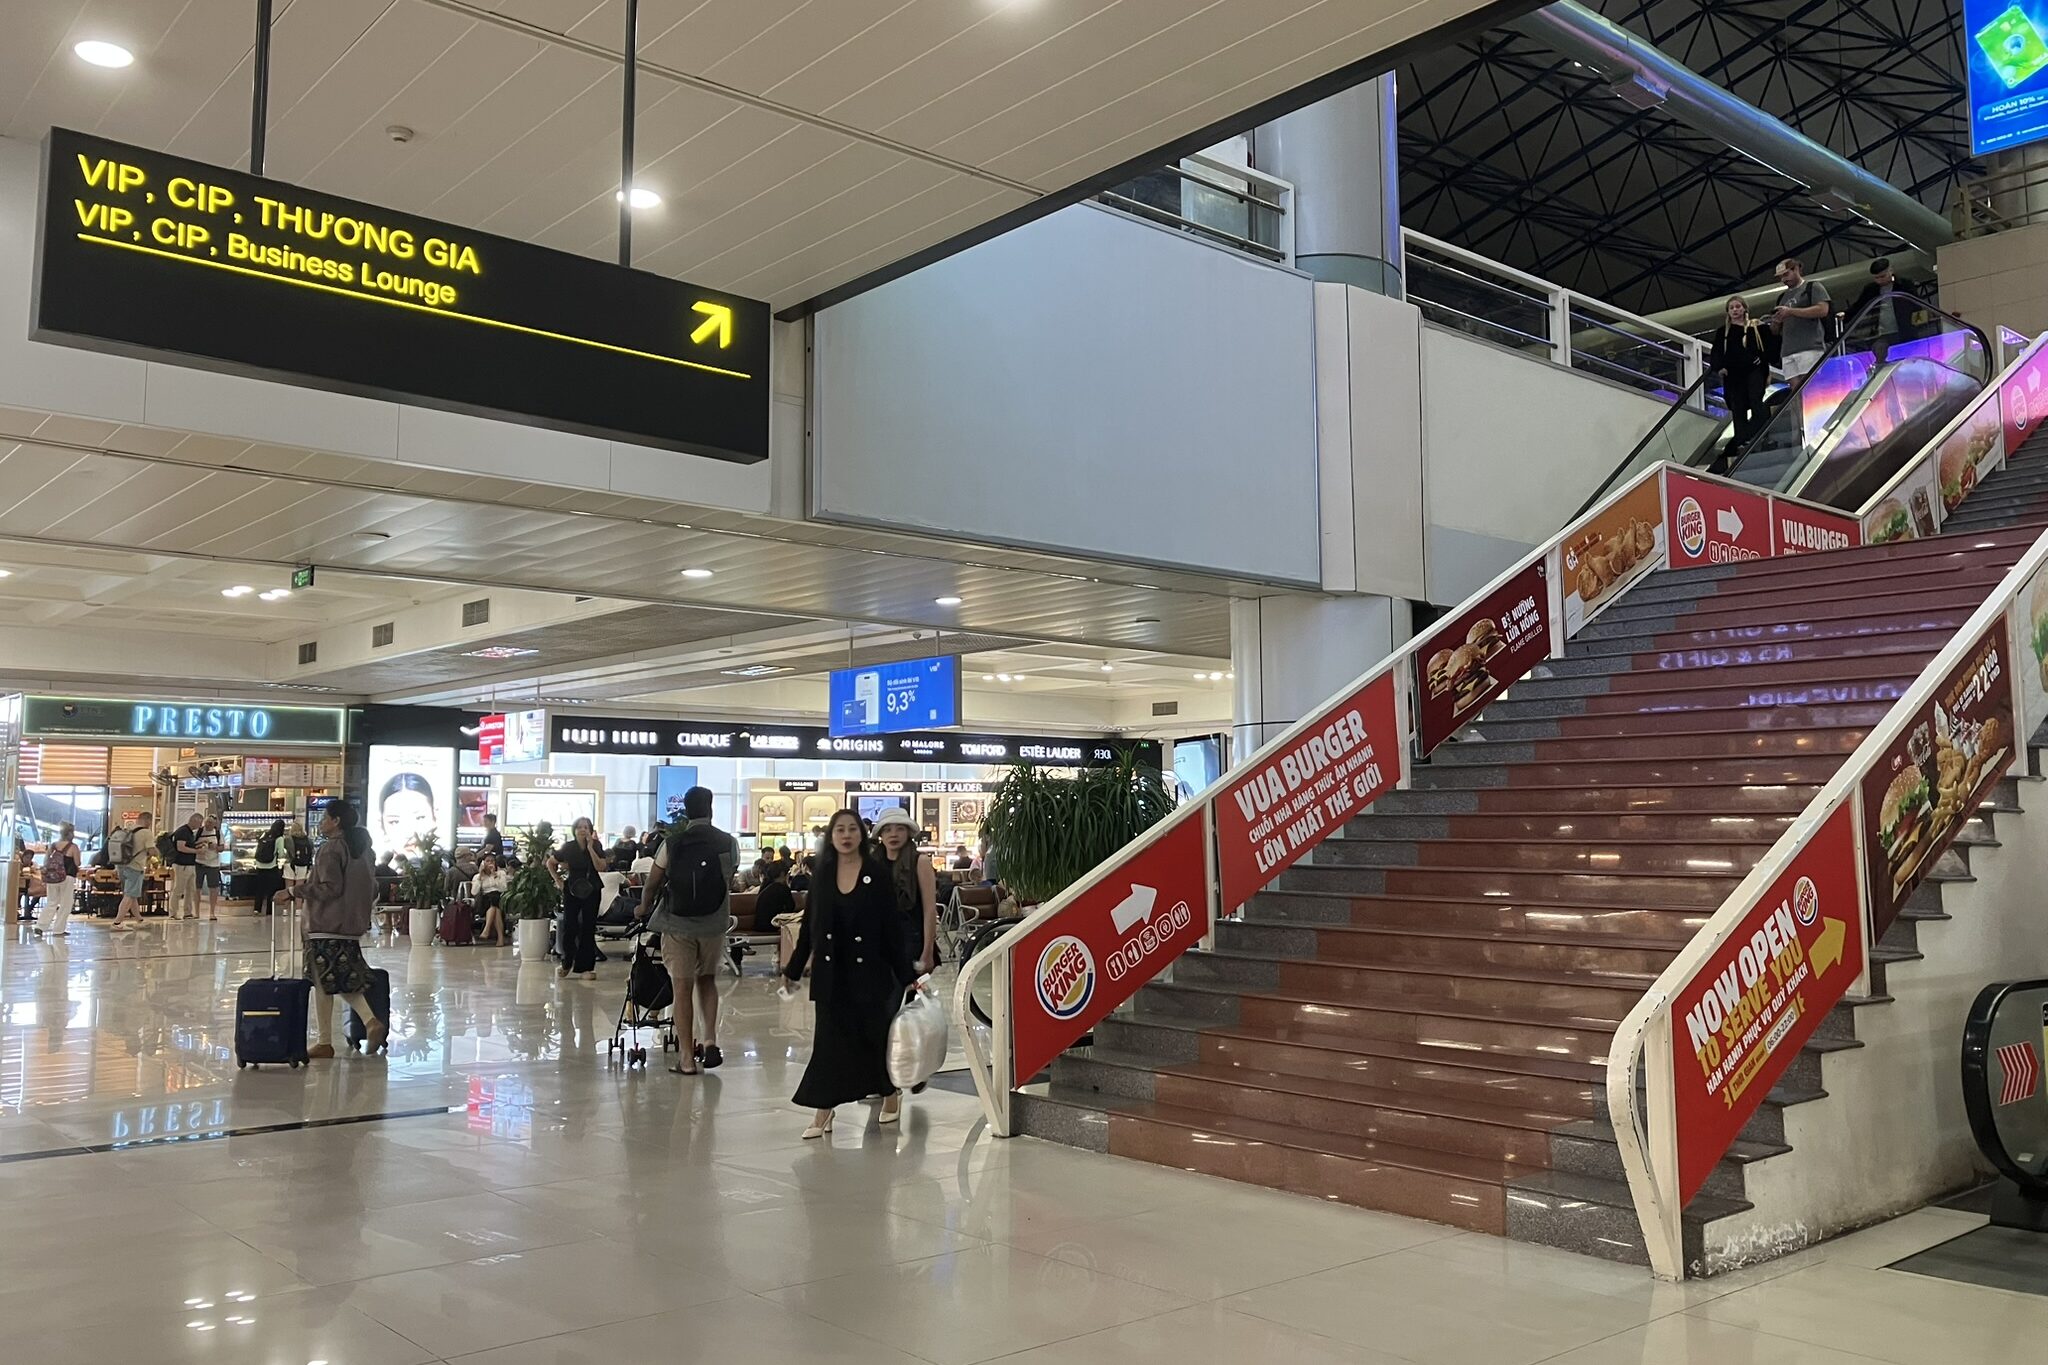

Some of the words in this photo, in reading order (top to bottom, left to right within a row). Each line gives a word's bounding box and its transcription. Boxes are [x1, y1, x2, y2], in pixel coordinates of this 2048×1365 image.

[76, 153, 154, 204] VIP,
[167, 176, 243, 224] CIP,
[253, 194, 415, 259] THƯƠNG
[423, 238, 482, 274] GIA
[74, 199, 141, 241] VIP,
[151, 217, 217, 256] CIP,
[227, 236, 354, 282] Business
[361, 261, 457, 305] Lounge
[1681, 511, 1701, 527] BURGER
[1682, 521, 1703, 541] KING
[1782, 518, 1807, 548] VUA
[1510, 637, 1526, 653] FLAME
[1525, 624, 1543, 642] GRILLED
[887, 690, 915, 715] 9,3%
[133, 705, 272, 738] PRESTO
[677, 733, 731, 748] CLINIQUE
[833, 739, 884, 752] ORIGINS
[900, 740, 911, 748] JO
[912, 741, 945, 749] MALONE
[960, 743, 981, 756] TOM
[981, 744, 1006, 757] FORD
[1019, 744, 1045, 758] ESTÉE
[1046, 746, 1082, 760] LAUDER
[1234, 765, 1287, 823] VUA
[1280, 709, 1368, 792] BURGER
[534, 777, 575, 788] CLINIQUE
[860, 782, 880, 792] TOM
[880, 782, 904, 792] FORD
[921, 781, 947, 792] ESTÉE
[948, 783, 983, 792] LAUDER
[1248, 814, 1275, 844] CHUỖI
[1273, 802, 1293, 826] NHÀ
[1291, 786, 1316, 812] HÀNG
[1313, 772, 1336, 796] THỨC
[1345, 744, 1375, 772] NHANH
[1255, 834, 1288, 874] LỚN
[1286, 803, 1325, 850] NHẤT
[1324, 778, 1354, 819] THẾ
[1353, 762, 1384, 798] GIỚI
[1043, 942, 1079, 996] BURGER
[1049, 952, 1087, 1012] KING
[1686, 961, 1740, 1053] NOW
[1738, 899, 1797, 989] OPEN
[1697, 1035, 1721, 1077] TO
[1720, 973, 1772, 1050] SERVE
[1770, 937, 1804, 986] YOU
[1722, 1047, 1744, 1079] HẠNH
[1744, 1024, 1763, 1050] PHỤC
[1761, 1009, 1773, 1027] VỤ
[1786, 961, 1809, 996] KHÁCH
[1766, 1011, 1795, 1050] 06:00-22:00
